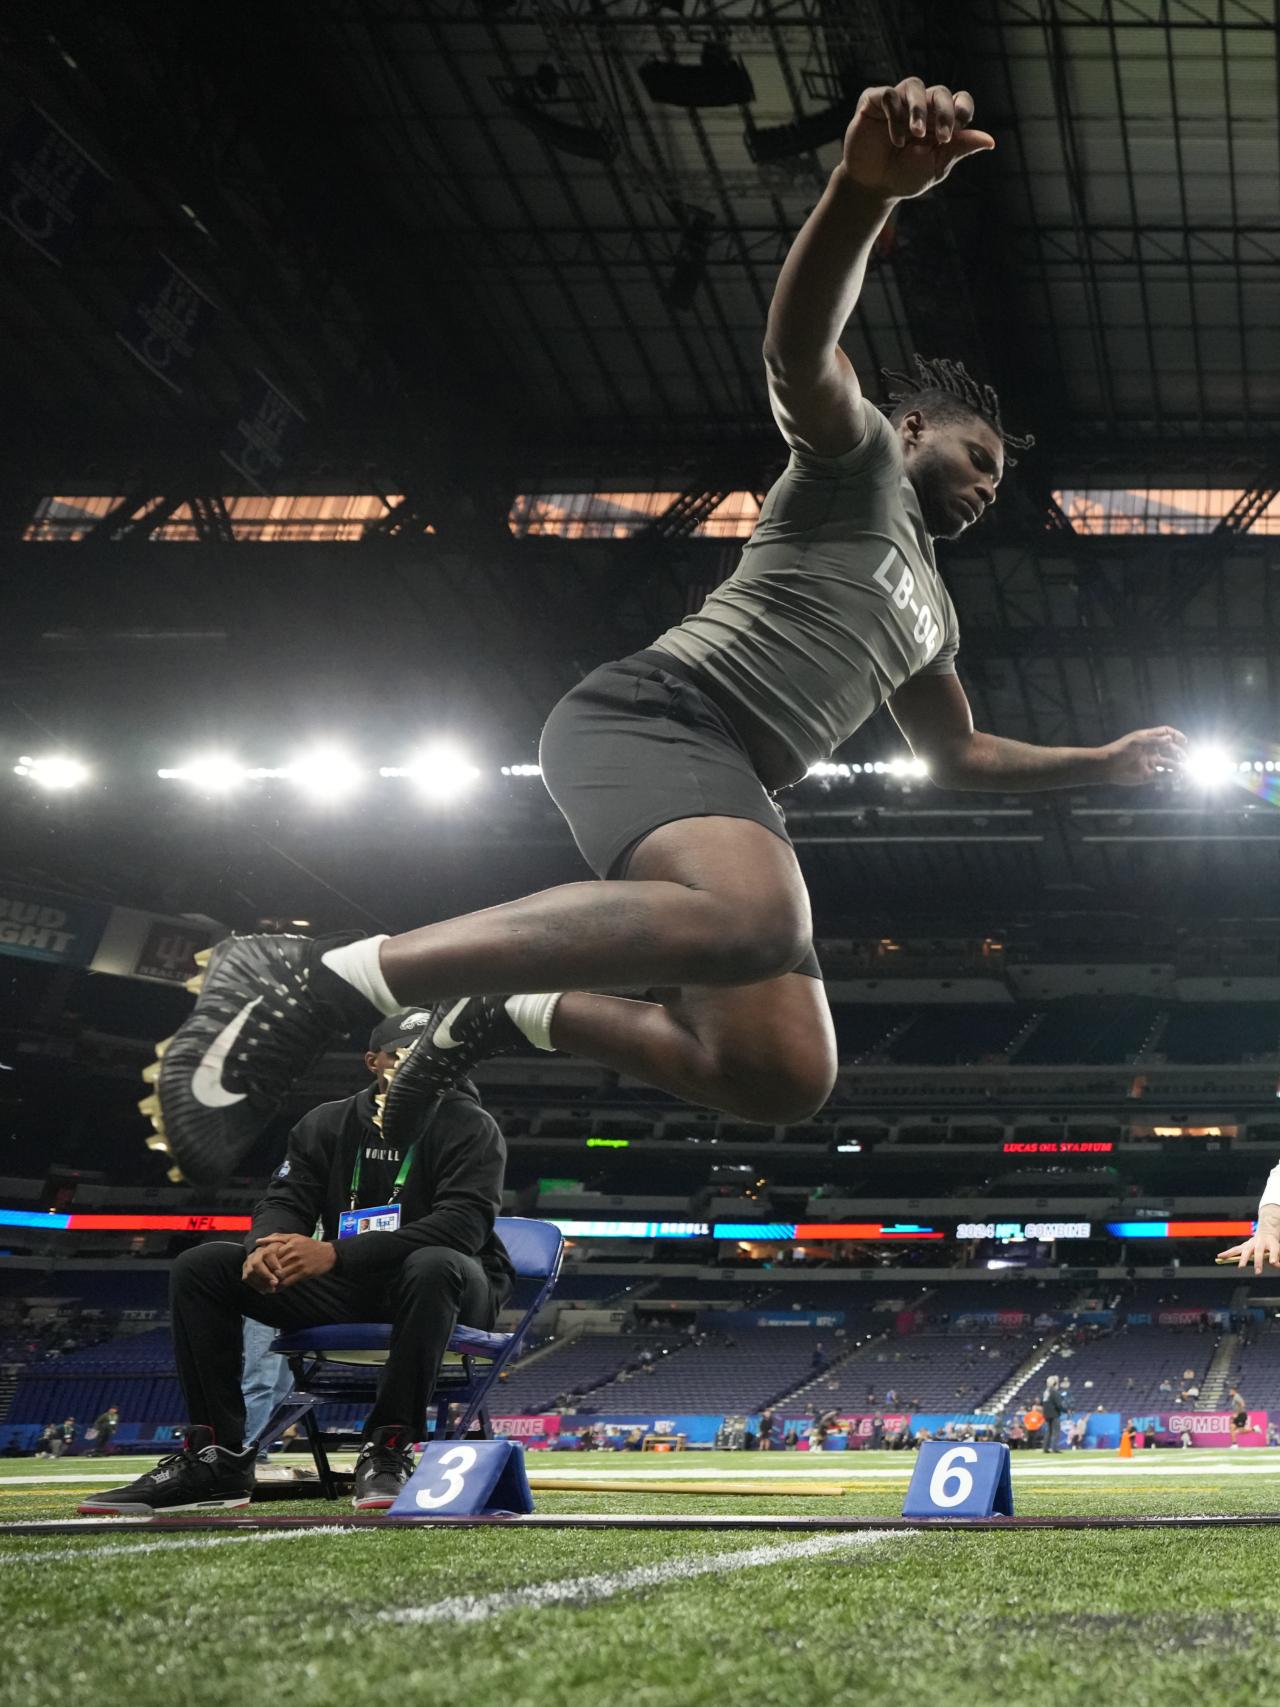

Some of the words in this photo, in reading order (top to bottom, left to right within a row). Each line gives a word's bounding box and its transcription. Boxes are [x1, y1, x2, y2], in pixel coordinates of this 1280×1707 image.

[1003, 1142, 1038, 1152] LUCAS
[1039, 1142, 1058, 1152] OIL
[1060, 1142, 1113, 1152] STADIUM
[186, 1217, 217, 1230] NFL
[956, 1223, 994, 1239] 2024
[1025, 1223, 1091, 1238] COMBINE
[1132, 1416, 1165, 1432] NFL
[415, 1445, 478, 1509] 3
[929, 1446, 978, 1508] 6
